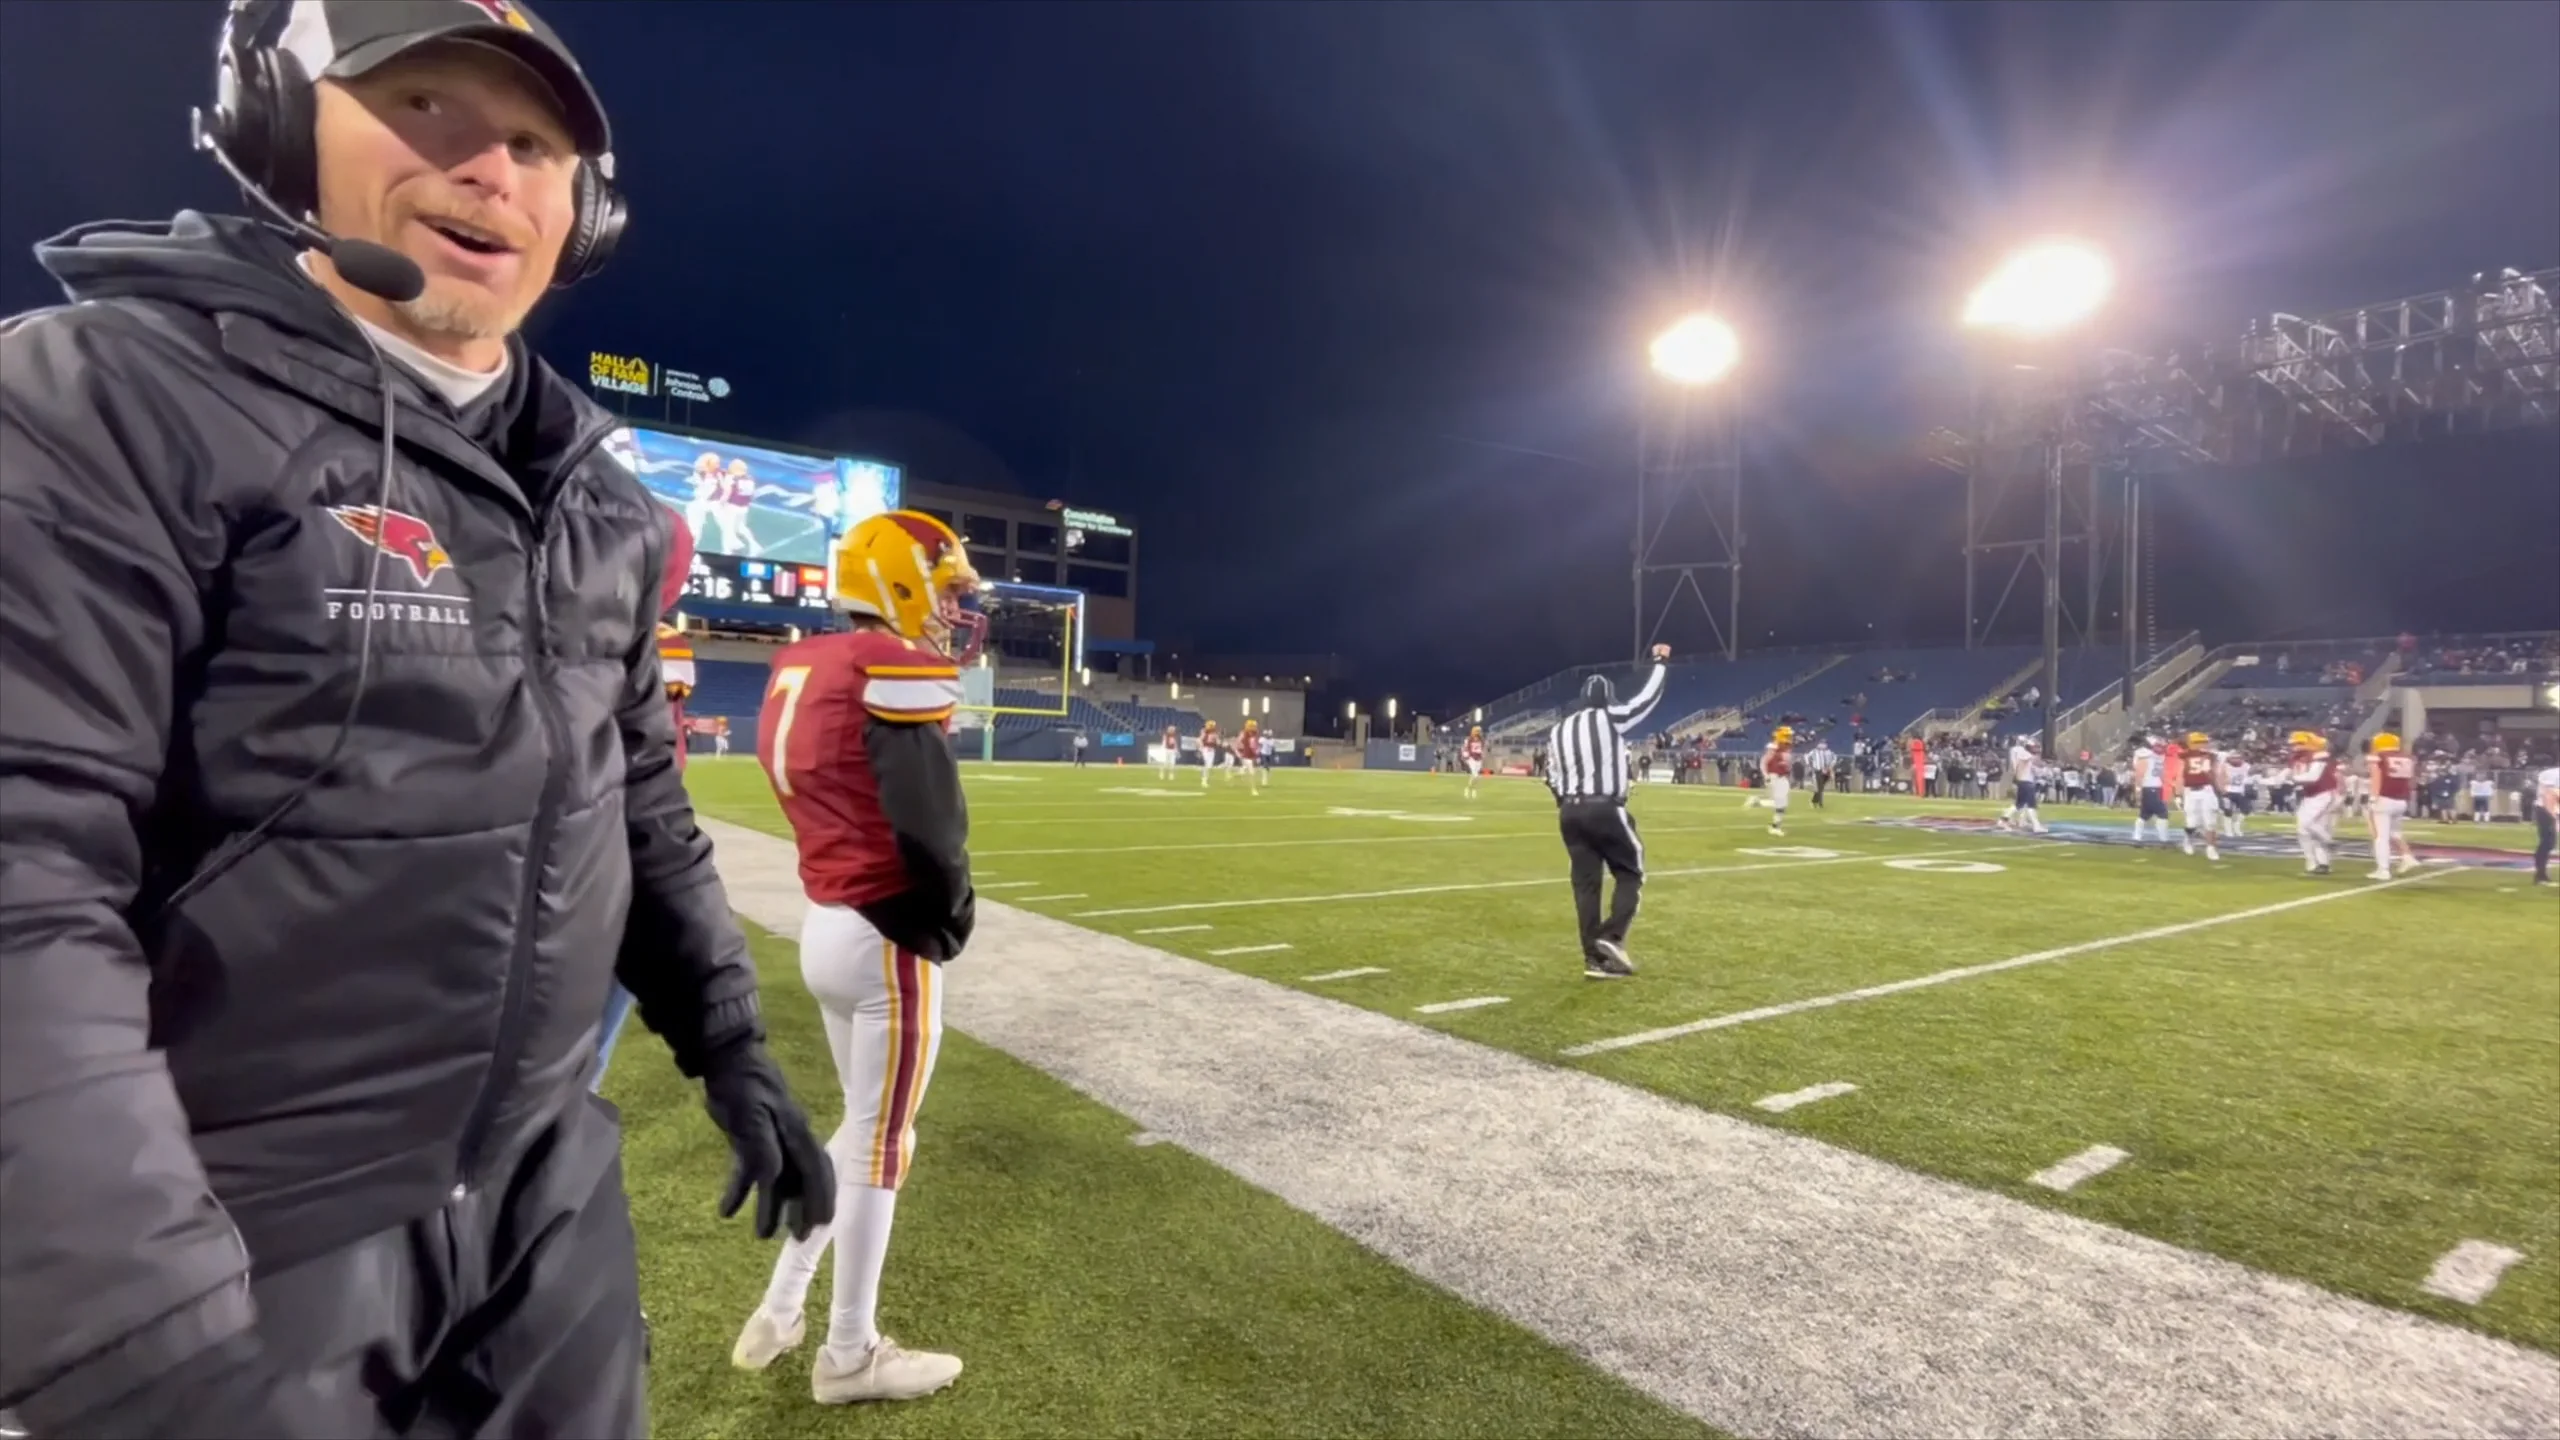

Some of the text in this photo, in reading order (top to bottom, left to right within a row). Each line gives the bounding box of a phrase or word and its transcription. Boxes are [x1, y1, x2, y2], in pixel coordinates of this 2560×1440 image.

[590, 351, 628, 368] HALL
[590, 363, 649, 386] OF FAME
[665, 376, 704, 392] Johnson
[590, 375, 649, 396] VILLAGE
[671, 386, 710, 402] Controls
[326, 602, 471, 625] FOOTBALL
[770, 665, 813, 797] 7
